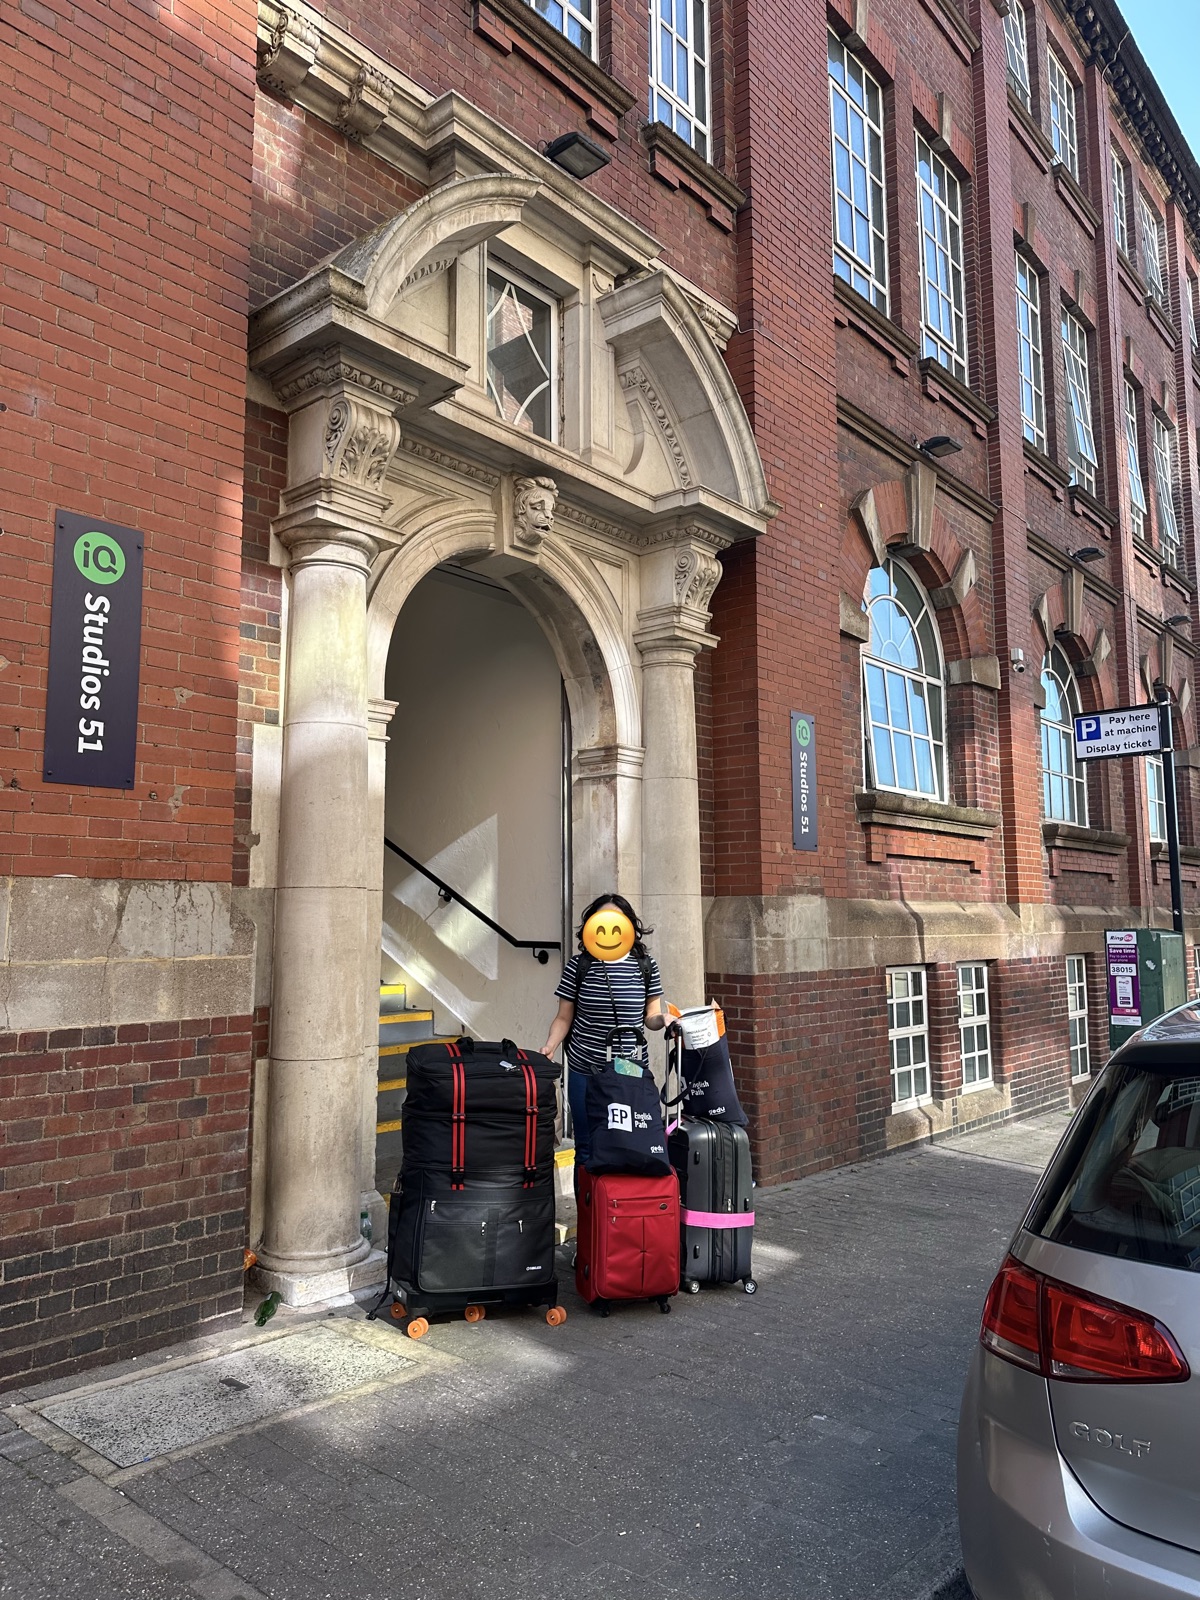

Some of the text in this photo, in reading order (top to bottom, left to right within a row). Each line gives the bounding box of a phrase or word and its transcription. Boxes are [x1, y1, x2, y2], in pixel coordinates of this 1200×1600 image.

[82, 540, 118, 576] iQ
[77, 592, 111, 754] Studios 51
[1109, 713, 1151, 724] Pay here
[1081, 719, 1097, 740] P
[1104, 724, 1157, 737] at machine
[1086, 739, 1152, 753] Display ticket
[800, 751, 809, 834] Studios 51
[690, 1088, 705, 1096] Path
[611, 1108, 628, 1125] EP
[634, 1111, 653, 1121] English
[634, 1120, 648, 1129] Path
[1069, 1421, 1152, 1458] GOLF
